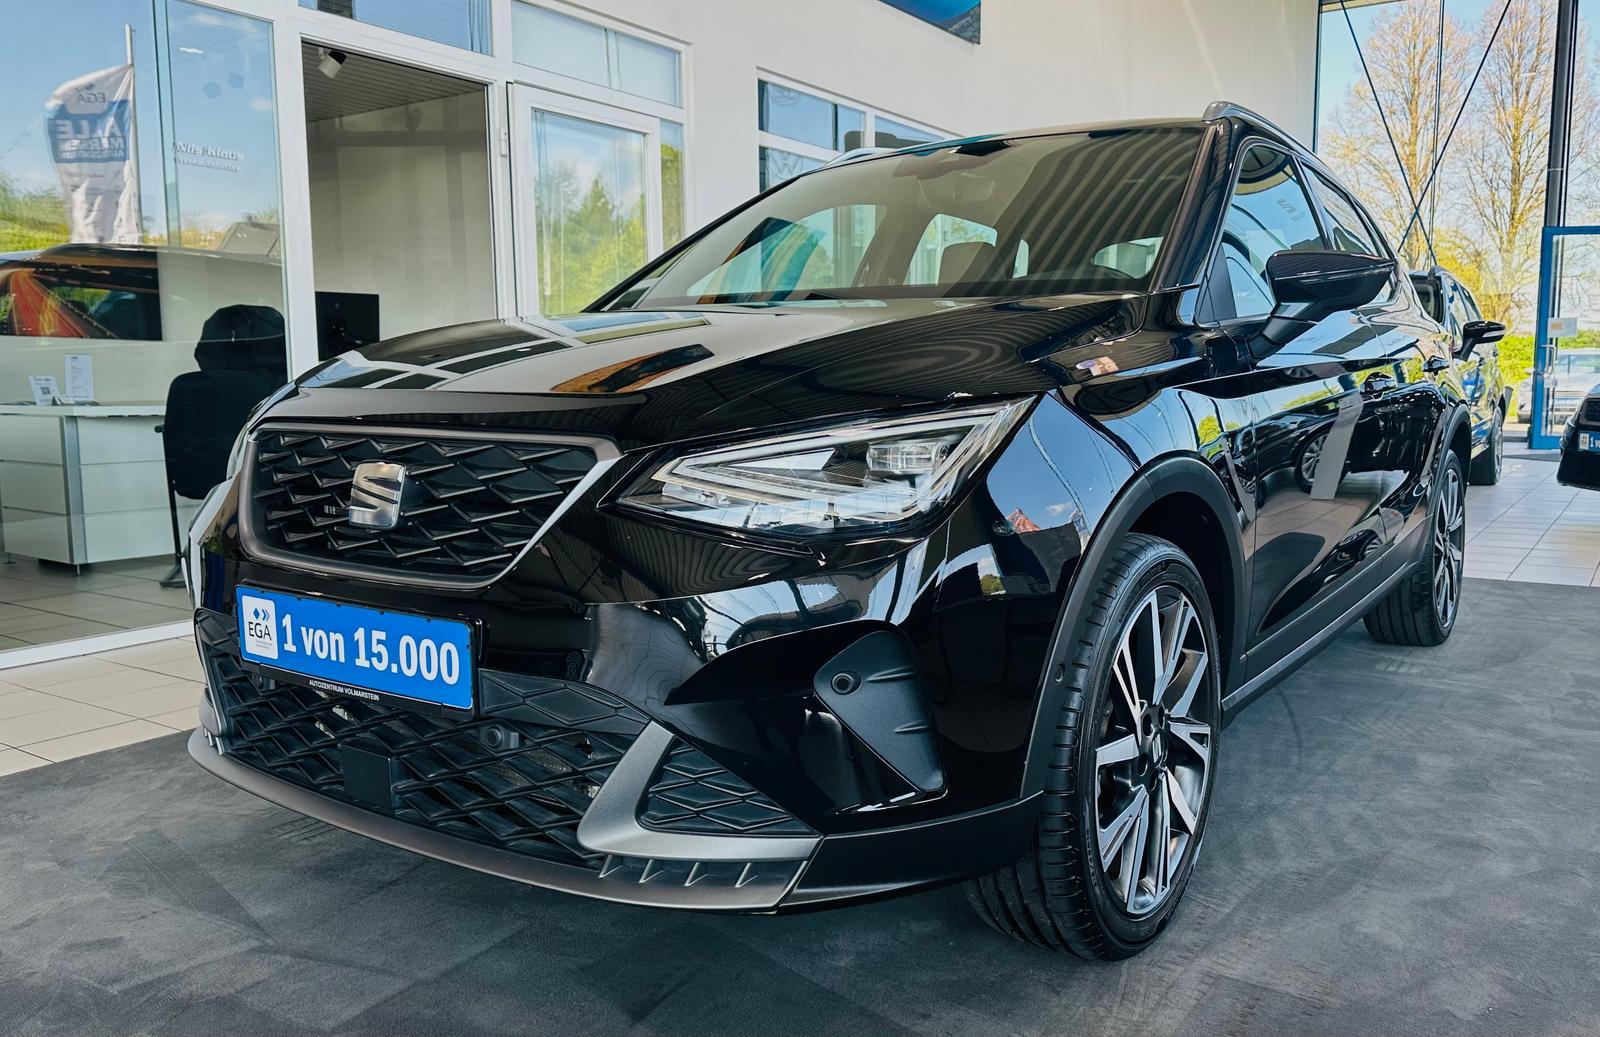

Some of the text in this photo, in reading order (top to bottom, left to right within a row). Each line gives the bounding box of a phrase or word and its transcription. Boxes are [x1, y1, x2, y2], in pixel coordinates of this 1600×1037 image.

[248, 621, 272, 641] EGA
[281, 614, 460, 686] 1 von 15.000
[308, 679, 380, 702] AUTOZENTRUM VOLMARSTEIN
